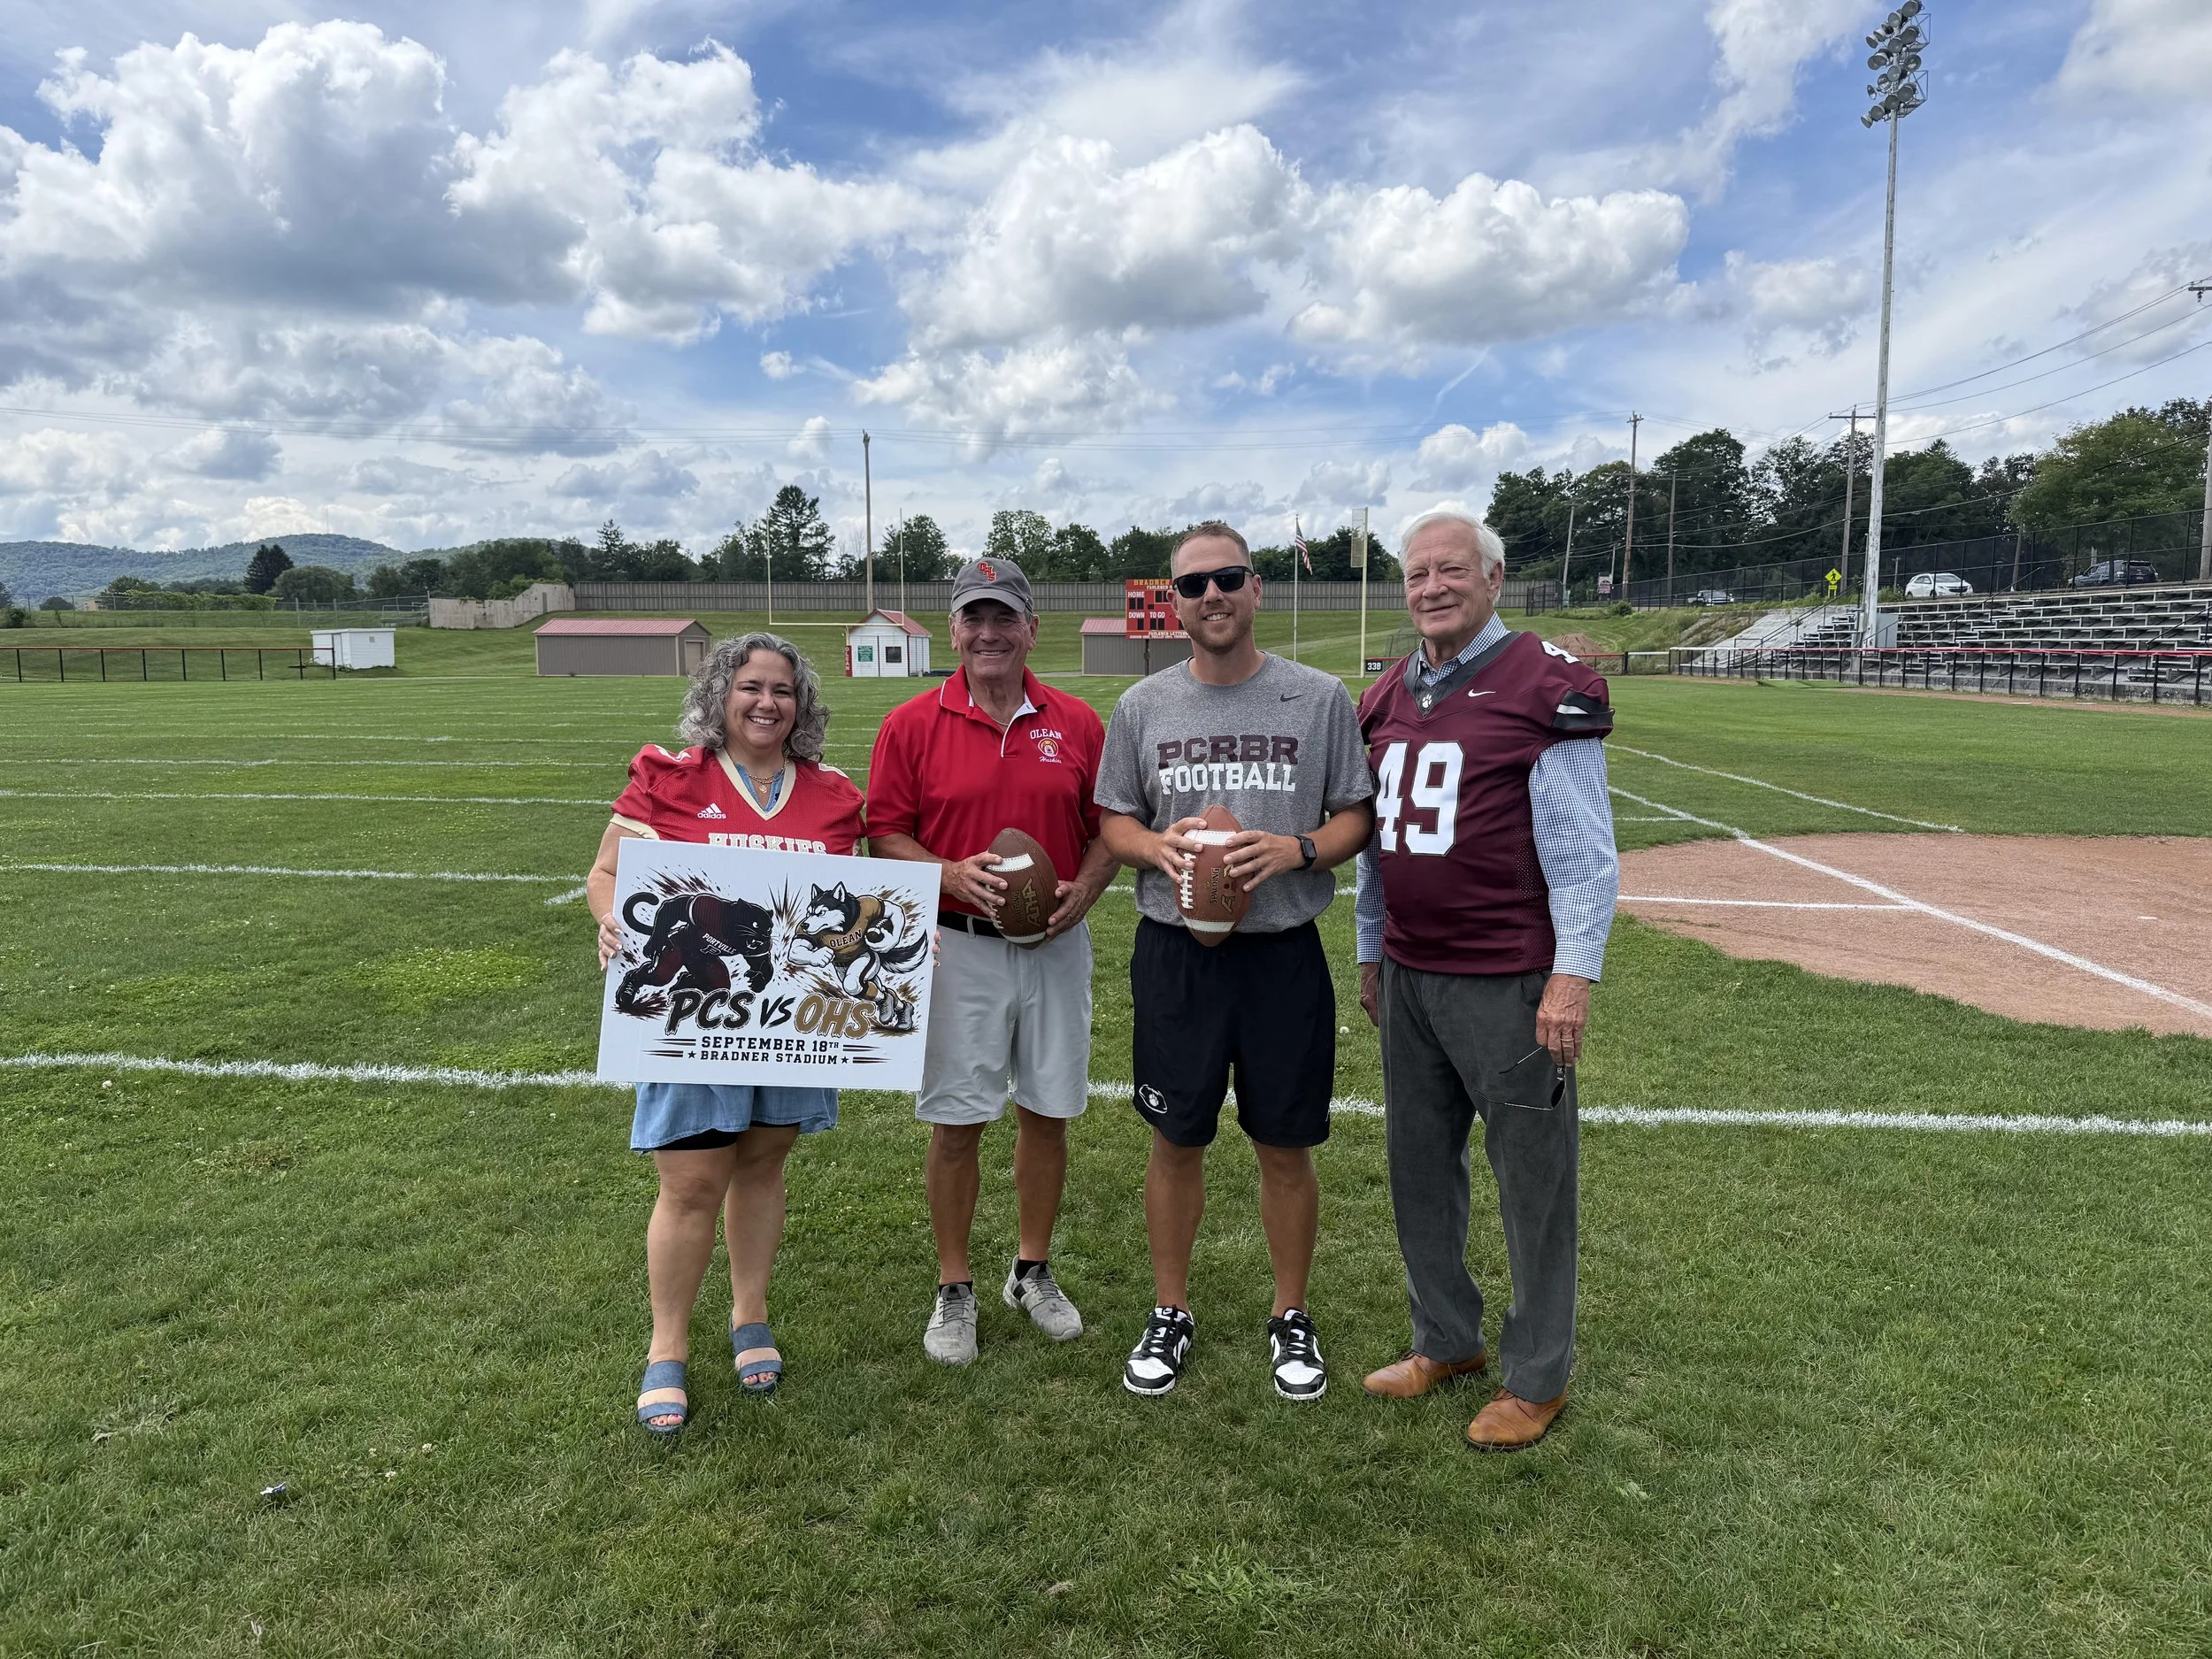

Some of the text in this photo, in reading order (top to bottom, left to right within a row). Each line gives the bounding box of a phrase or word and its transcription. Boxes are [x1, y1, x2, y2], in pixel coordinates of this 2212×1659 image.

[1367, 662, 1381, 671] 338
[1029, 728, 1063, 741] OLEAN
[1039, 756, 1062, 764] Huskies
[1156, 734, 1299, 770] PCRBR
[1158, 762, 1296, 795] FOOTBALL
[1376, 739, 1465, 857] 49
[1210, 867, 1220, 904] SPALDING
[702, 933, 737, 955] PORTVILLE
[829, 928, 863, 948] OLEAN
[664, 987, 877, 1040] PCS VS OHS
[702, 1036, 805, 1052] SEPTEMBER
[700, 1050, 838, 1064] BRADNER STADIUM
